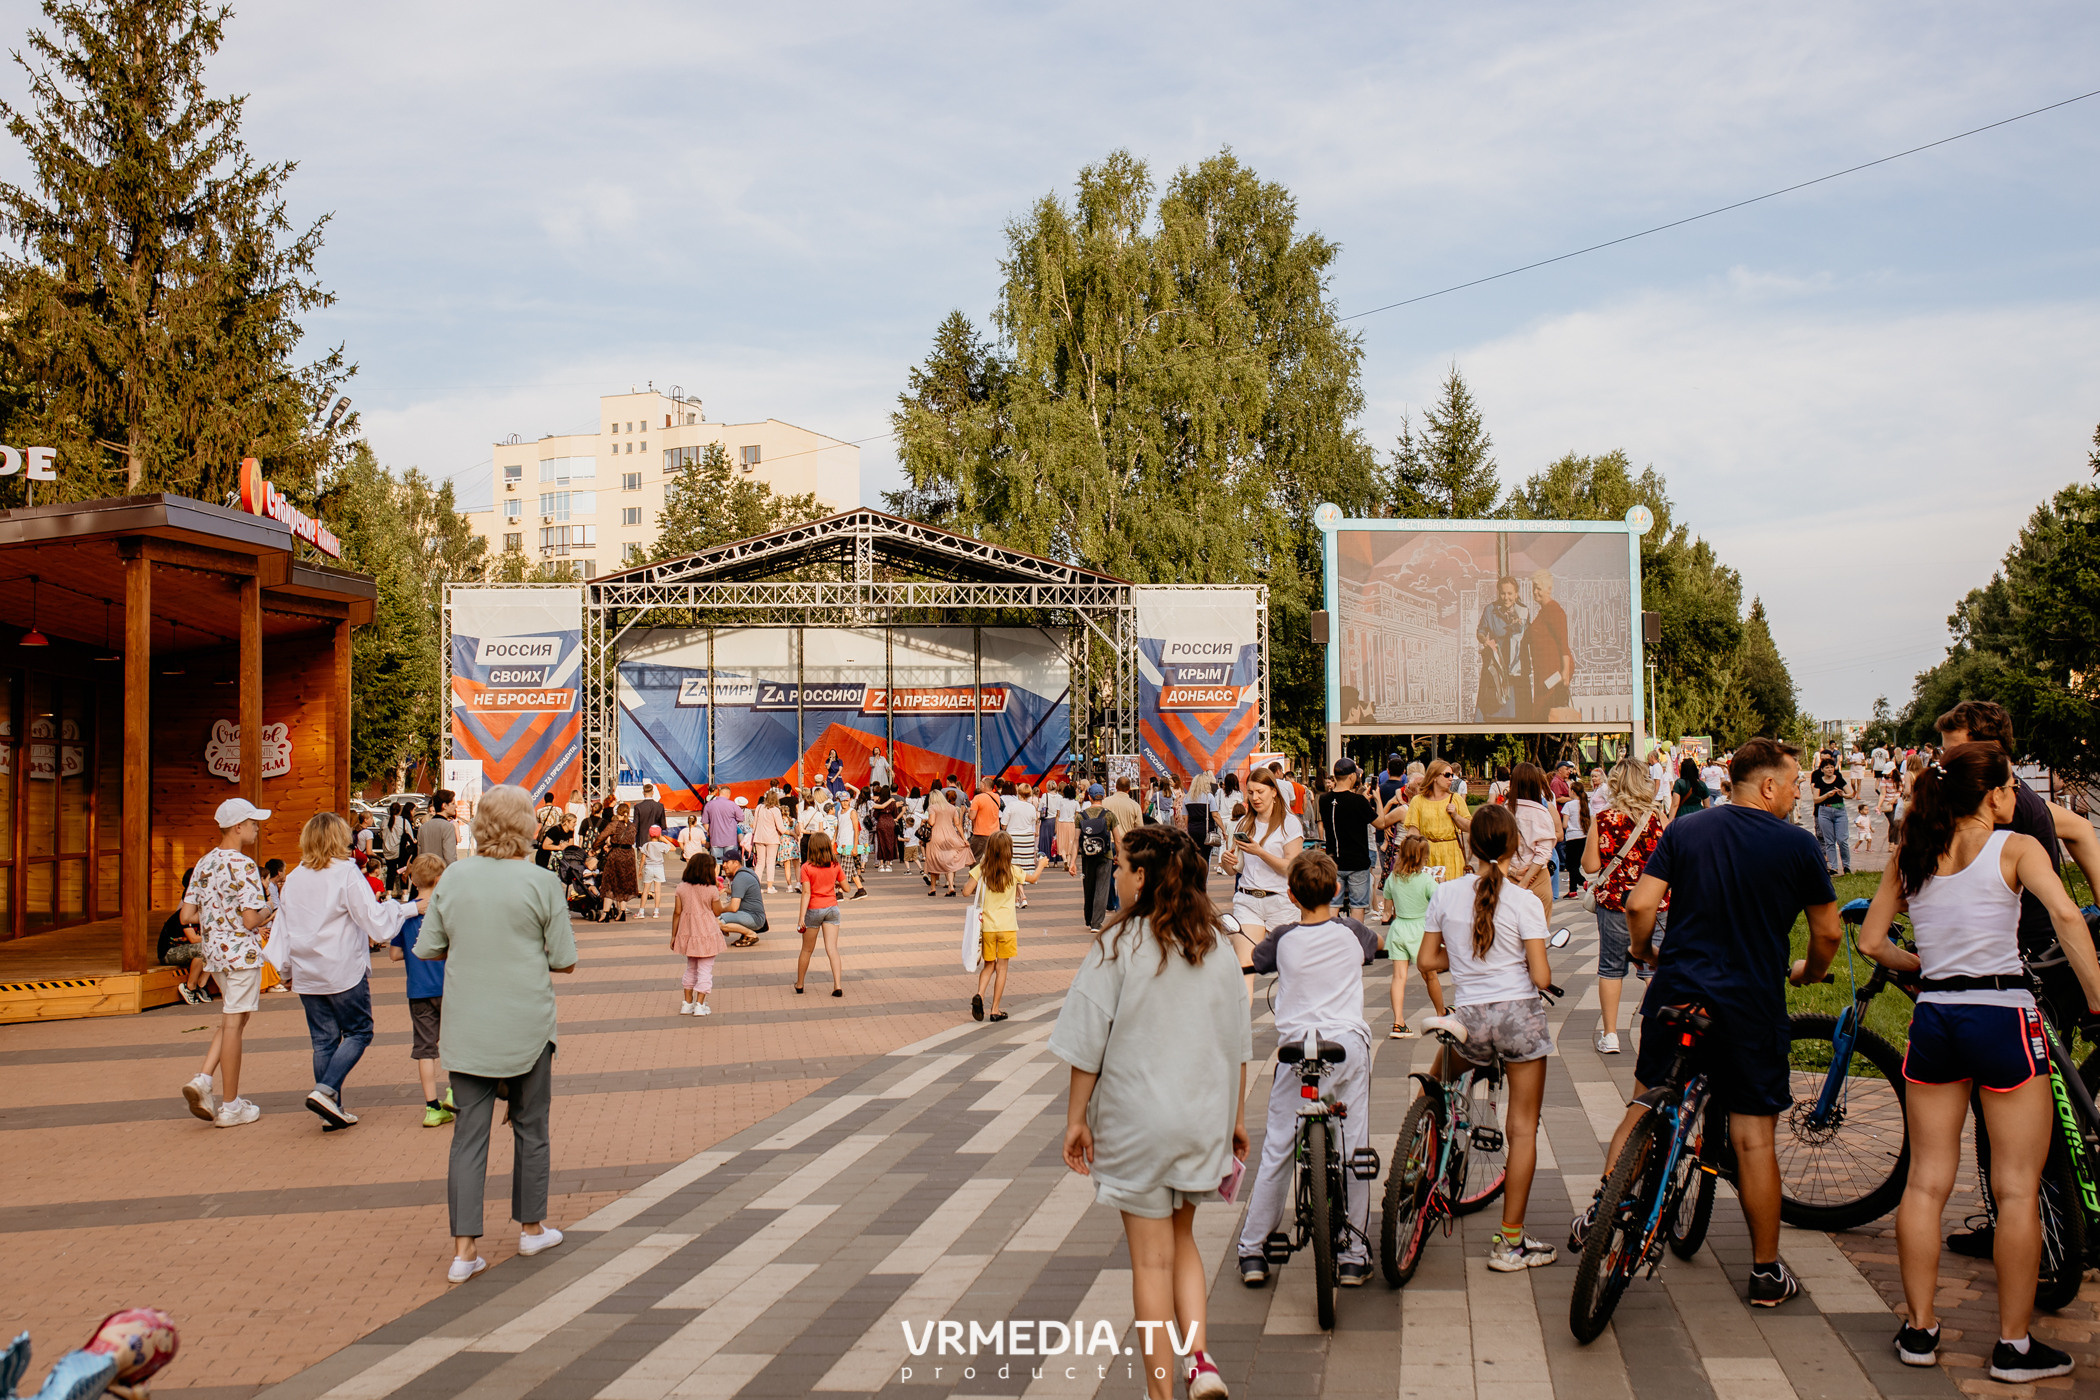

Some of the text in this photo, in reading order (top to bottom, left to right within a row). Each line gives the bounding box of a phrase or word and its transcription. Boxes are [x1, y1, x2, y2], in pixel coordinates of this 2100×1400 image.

[266, 481, 316, 543] Сибирские
[1397, 520, 1571, 531] ФЕСТИВАЛЬ БОЛЕЛЬЩИКОВ КЕМЕРОВО
[485, 644, 553, 657] РОССИЯ
[1171, 643, 1234, 655] РОССИЯ
[490, 670, 543, 683] СВОИХ
[1177, 668, 1222, 680] КРЫМ
[716, 684, 753, 697] МИР!
[789, 690, 861, 703] РОССИЮ!
[1166, 690, 1233, 704] ДОНБАСС
[473, 692, 568, 705] НЕ БРОСАЕТ!
[903, 695, 1002, 708] ПРЕЗИДЕНТА!
[1143, 747, 1165, 771] РОССИЯ
